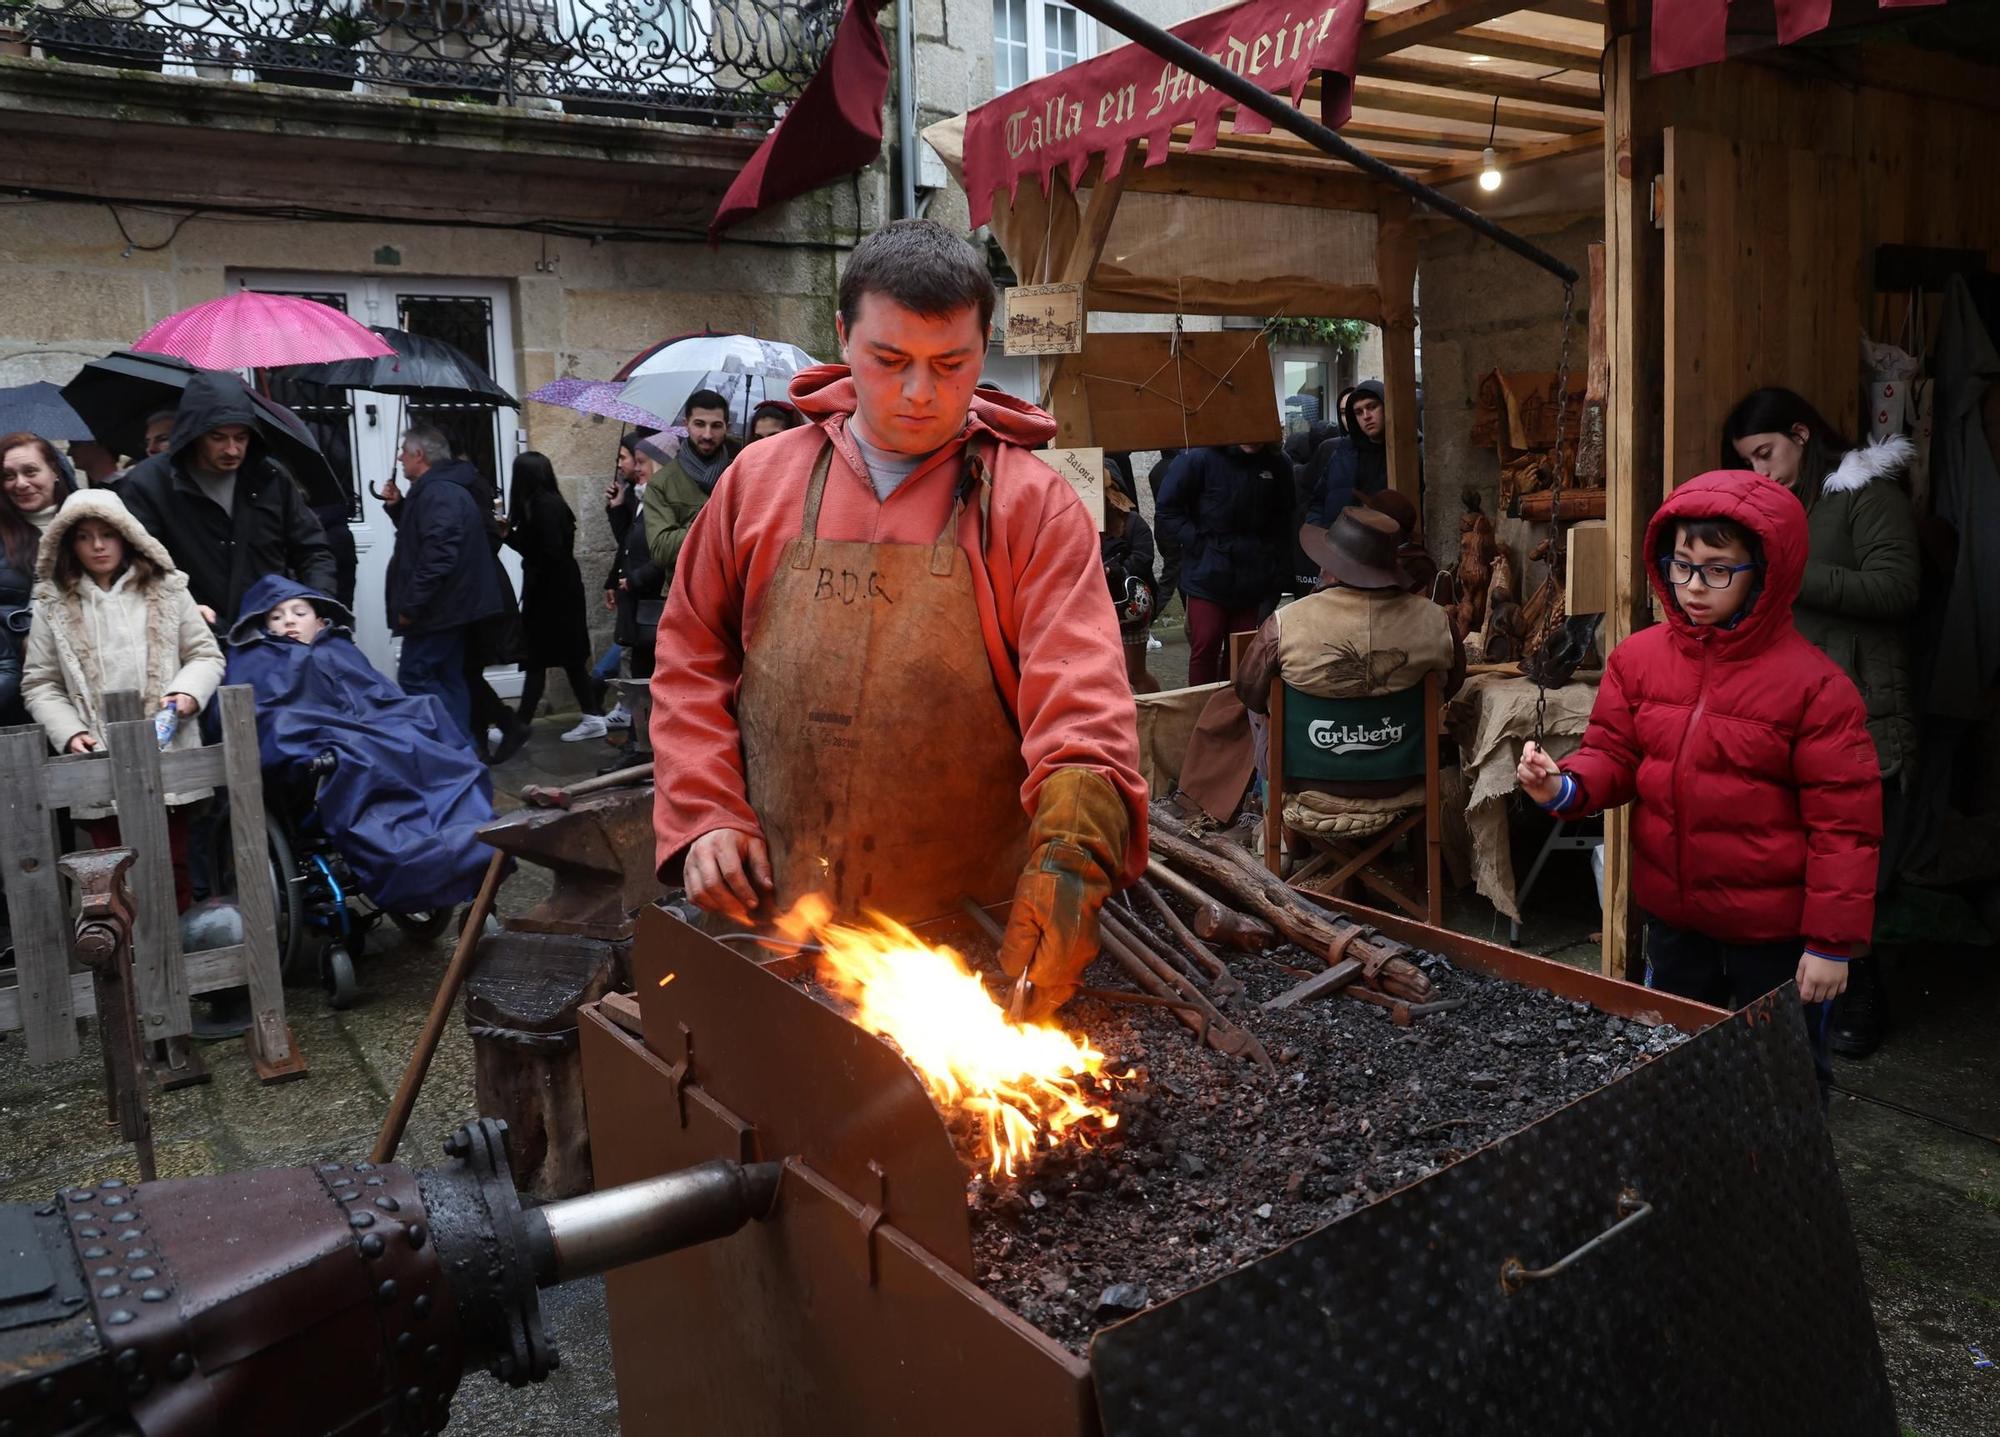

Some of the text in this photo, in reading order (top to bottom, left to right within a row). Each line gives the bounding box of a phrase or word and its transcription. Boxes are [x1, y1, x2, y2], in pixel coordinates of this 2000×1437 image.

[1005, 93, 1084, 159] Talla
[1096, 83, 1137, 128] en
[1308, 718, 1403, 748] Carlsberg
